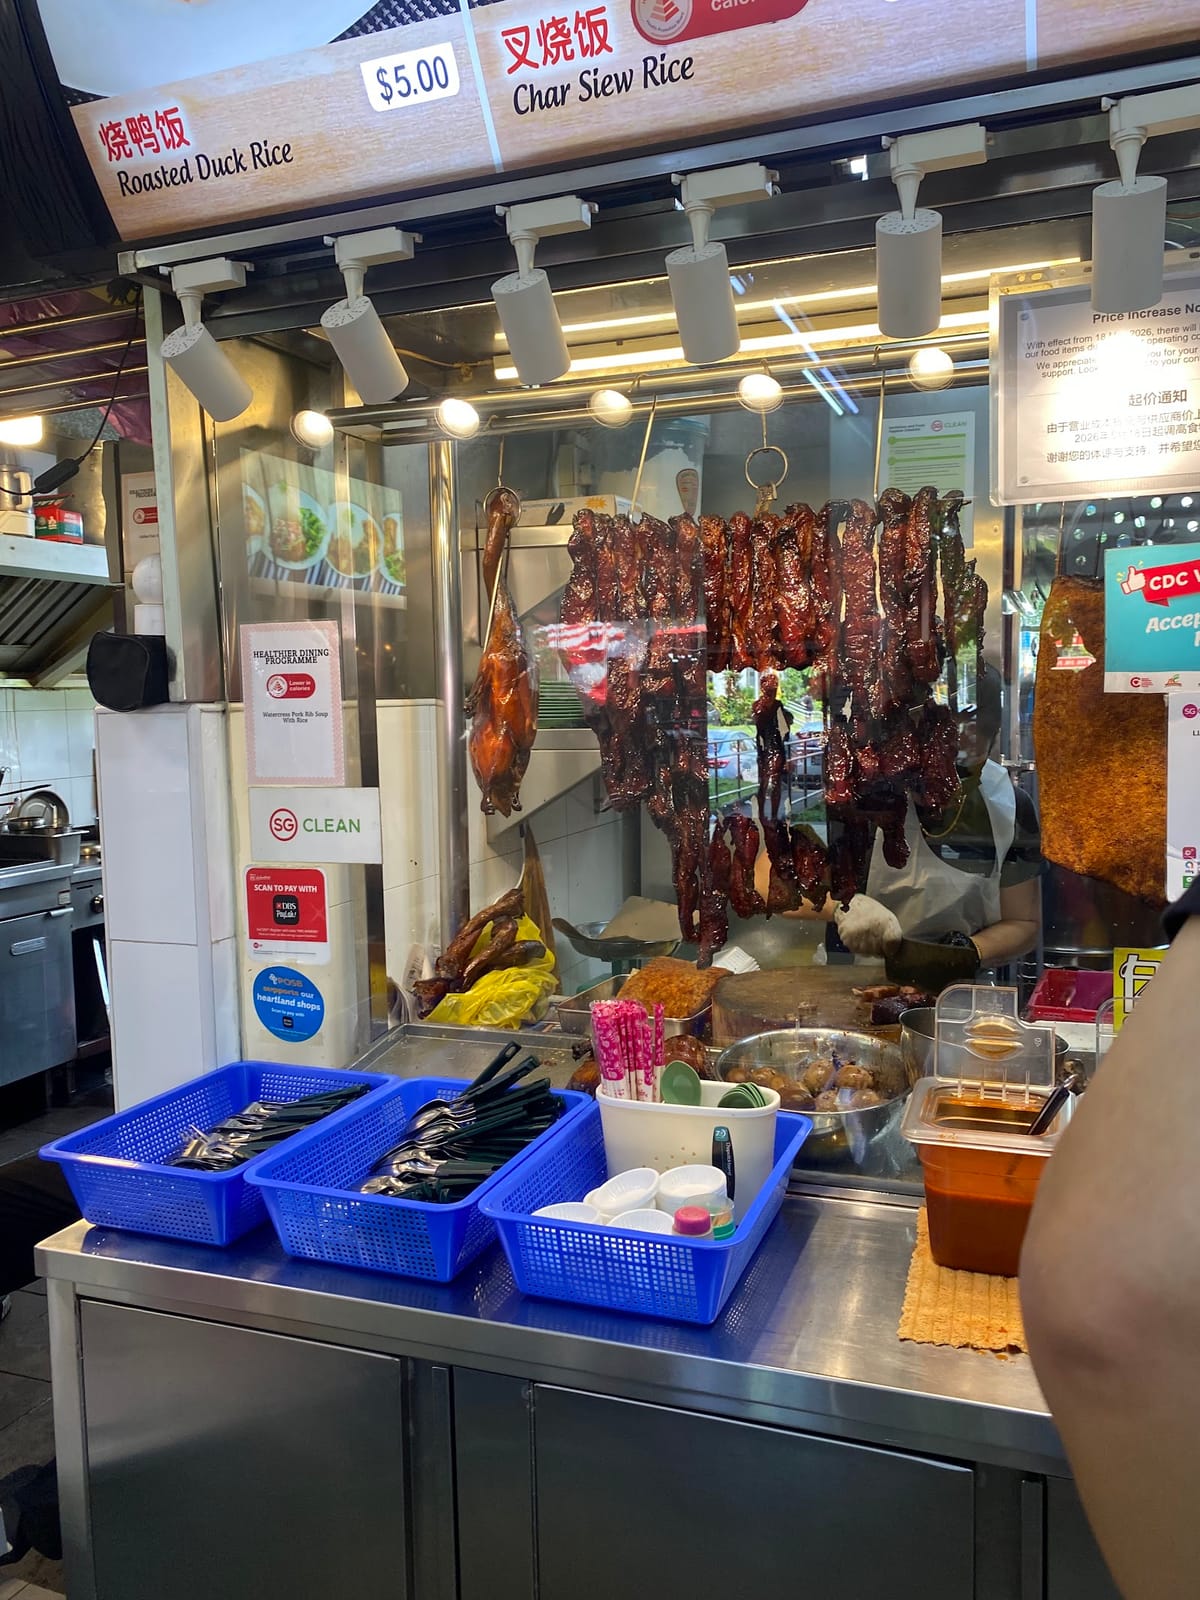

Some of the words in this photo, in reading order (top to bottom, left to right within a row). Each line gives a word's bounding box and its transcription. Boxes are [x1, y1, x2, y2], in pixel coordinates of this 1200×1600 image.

[501, 6, 614, 75] 叉烧饭
[376, 56, 449, 105] $5.00
[514, 82, 571, 115] Char
[578, 67, 634, 102] Siew
[642, 53, 695, 88] Rice
[98, 107, 191, 162] 烧鸭饭
[117, 158, 194, 197] Roasted
[195, 148, 248, 180] Duck
[250, 140, 294, 170] Rice
[1092, 312, 1125, 324] Price
[1128, 306, 1181, 320] Increase
[1026, 341, 1046, 350] With
[1047, 337, 1071, 348] effect
[1073, 335, 1093, 344] from
[1096, 333, 1106, 341] 18
[1157, 326, 1180, 336] there
[1182, 323, 1197, 332] will
[1025, 350, 1039, 359] our
[1041, 347, 1060, 357] food
[1062, 344, 1085, 354] items
[1146, 333, 1189, 346] operating
[1036, 361, 1051, 370] We
[1147, 350, 1161, 358] ou
[1164, 347, 1176, 356] for
[1178, 346, 1198, 357] your
[1160, 357, 1181, 368] your
[1128, 389, 1188, 407] 起价通知
[1149, 571, 1189, 591] CDC
[253, 650, 298, 658] HEALTHIER
[265, 656, 318, 664] PROGRAMME
[315, 710, 329, 719] Soup
[273, 818, 295, 832] SG
[302, 818, 361, 833] CLEAN
[254, 884, 273, 892] SCAN
[274, 884, 284, 892] TO
[284, 884, 298, 893] PAY
[298, 885, 318, 893] WITH
[282, 902, 297, 910] DBS
[277, 977, 303, 987] POSB
[256, 993, 295, 1006] heartland
[297, 1000, 321, 1011] shops
[300, 991, 315, 999] our
